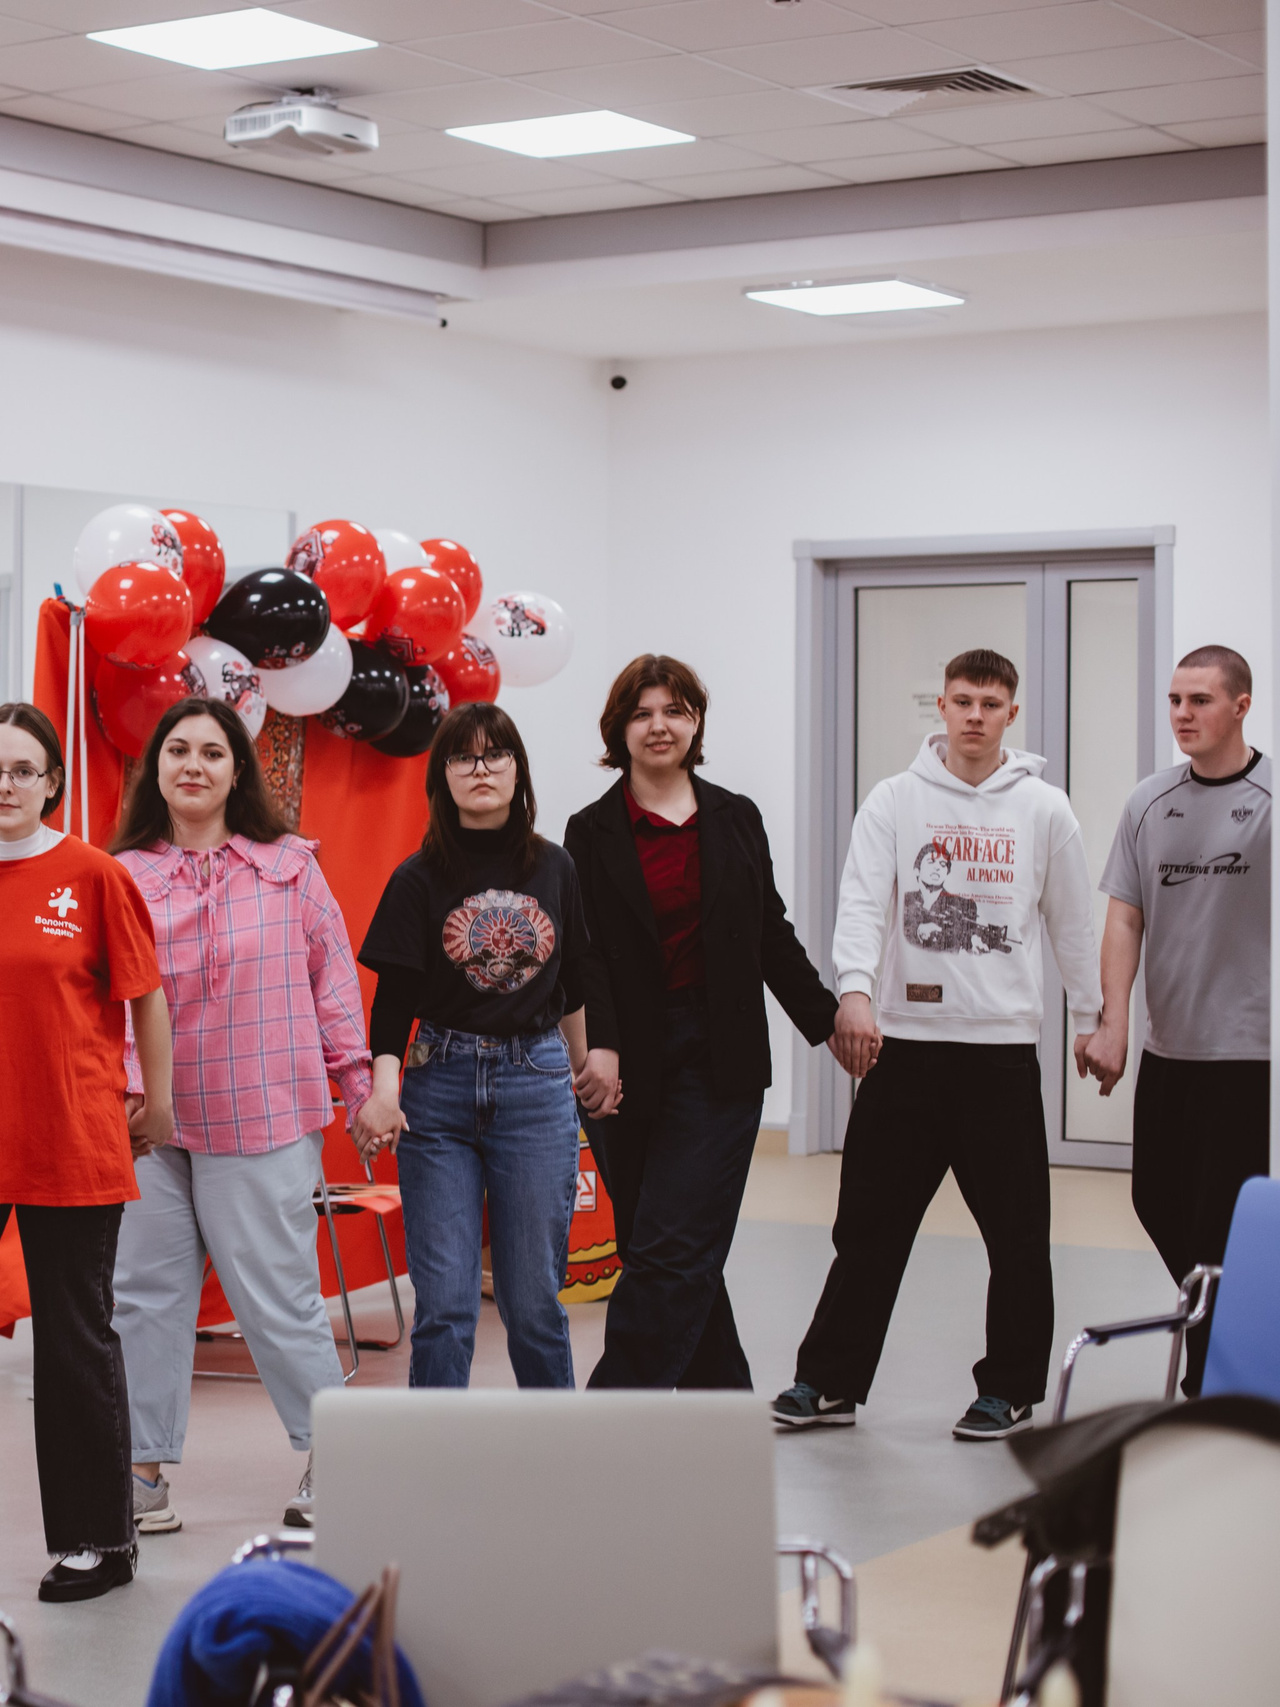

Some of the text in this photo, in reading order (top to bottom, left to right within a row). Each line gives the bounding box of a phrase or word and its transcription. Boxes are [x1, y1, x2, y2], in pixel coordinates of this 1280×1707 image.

[931, 835, 1015, 865] SCARFACE
[966, 868, 1014, 883] AL PACINO
[1212, 865, 1250, 875] SPORT
[34, 915, 82, 933] Волонтеры
[42, 926, 74, 939] медики
